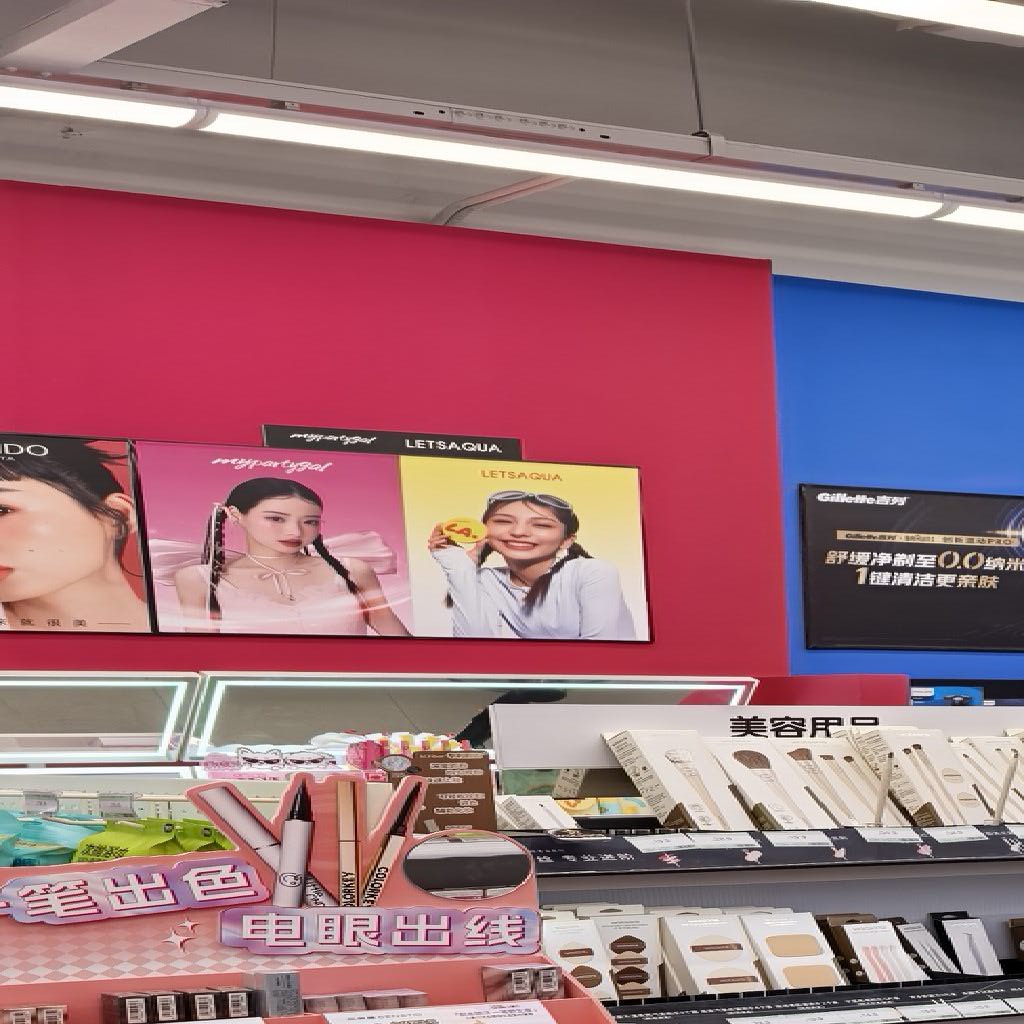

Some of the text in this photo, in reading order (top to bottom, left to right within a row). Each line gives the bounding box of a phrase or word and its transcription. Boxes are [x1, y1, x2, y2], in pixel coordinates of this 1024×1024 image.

[0, 442, 48, 457] DO
[405, 438, 503, 454] LETSAQUA
[481, 470, 563, 482] LETSAQUA
[0, 864, 260, 918] 笔出色
[241, 912, 527, 948] 电眼出线
